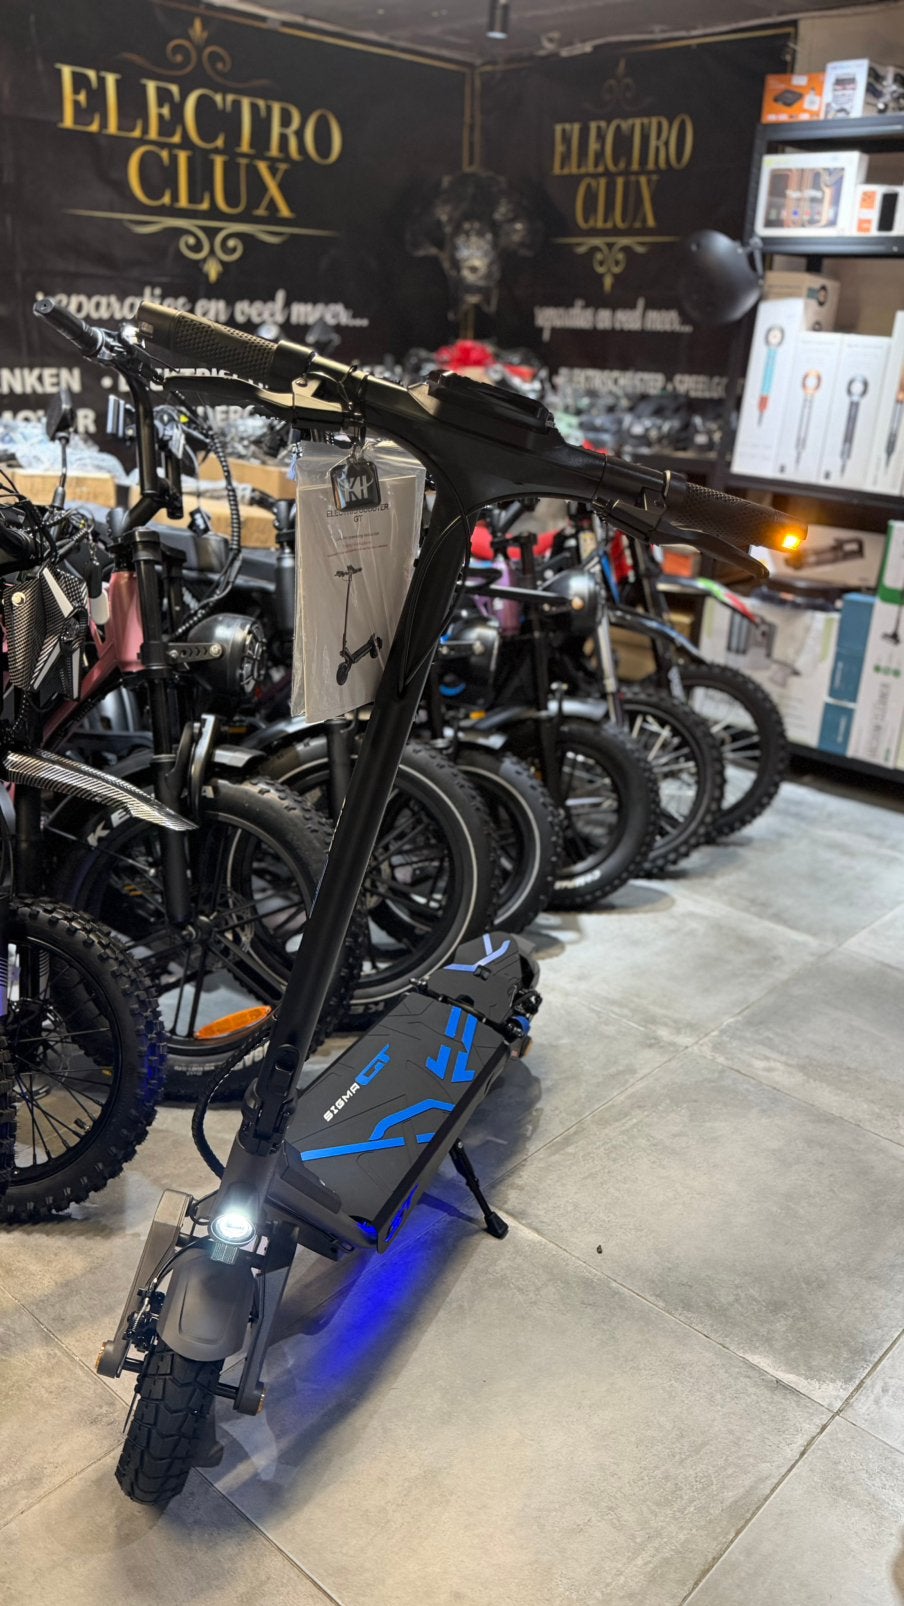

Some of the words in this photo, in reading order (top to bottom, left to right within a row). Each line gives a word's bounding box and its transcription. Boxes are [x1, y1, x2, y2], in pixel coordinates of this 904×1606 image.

[55, 62, 343, 165] ELECTRO
[553, 113, 693, 176] ELECTRO
[127, 144, 296, 219] CLUX
[575, 174, 660, 230] CLUX
[0, 366, 83, 394] NKEN
[323, 1082, 360, 1122] SIGMA
[355, 1043, 391, 1086] GT
